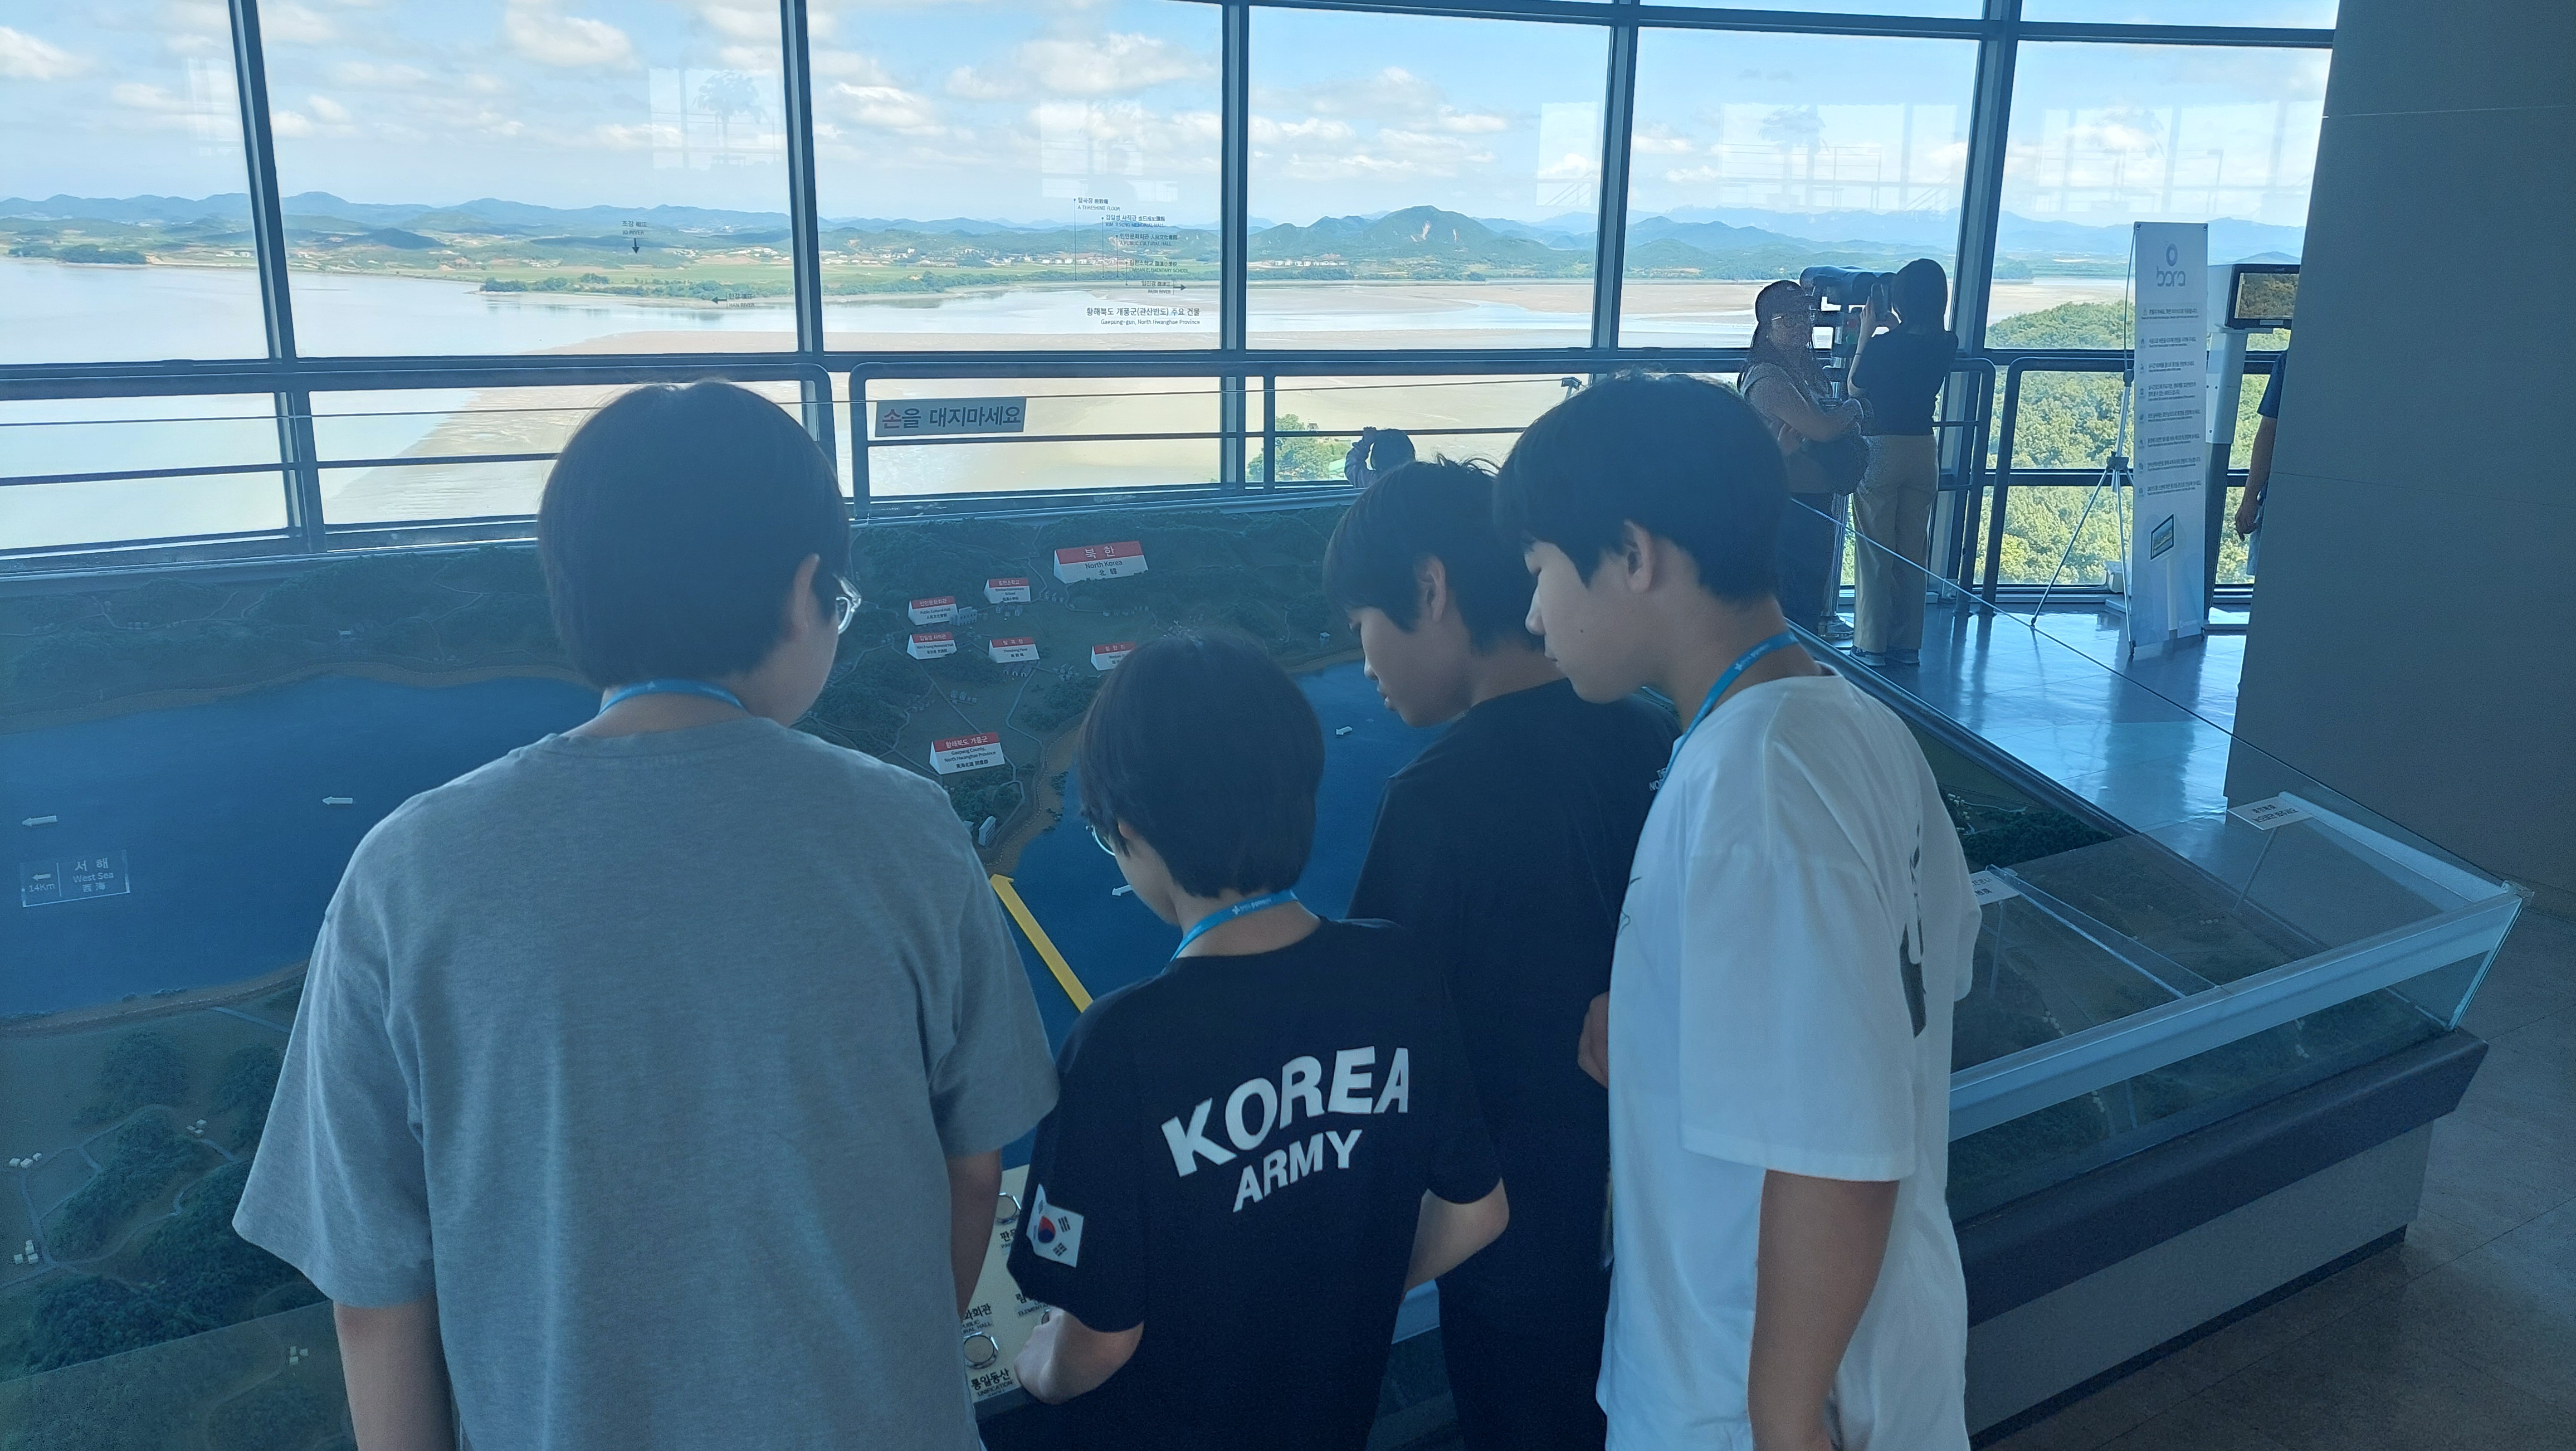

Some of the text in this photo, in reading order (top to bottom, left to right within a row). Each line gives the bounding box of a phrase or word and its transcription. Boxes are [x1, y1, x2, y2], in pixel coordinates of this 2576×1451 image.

[1086, 308, 1201, 316] 황해북도 개풍군(관산반도) 주요 건물
[882, 406, 1021, 429] 손을 대지마세요
[1085, 559, 1123, 569] North Korea
[945, 739, 969, 748] 황해북도
[73, 871, 114, 883] West Sea
[28, 883, 55, 893] 14Km
[1160, 1045, 1409, 1177] KOREA
[1232, 1129, 1363, 1214] ARMY
[971, 1368, 1011, 1391] 통일동산
[977, 1380, 1013, 1397] UNIFICATION
